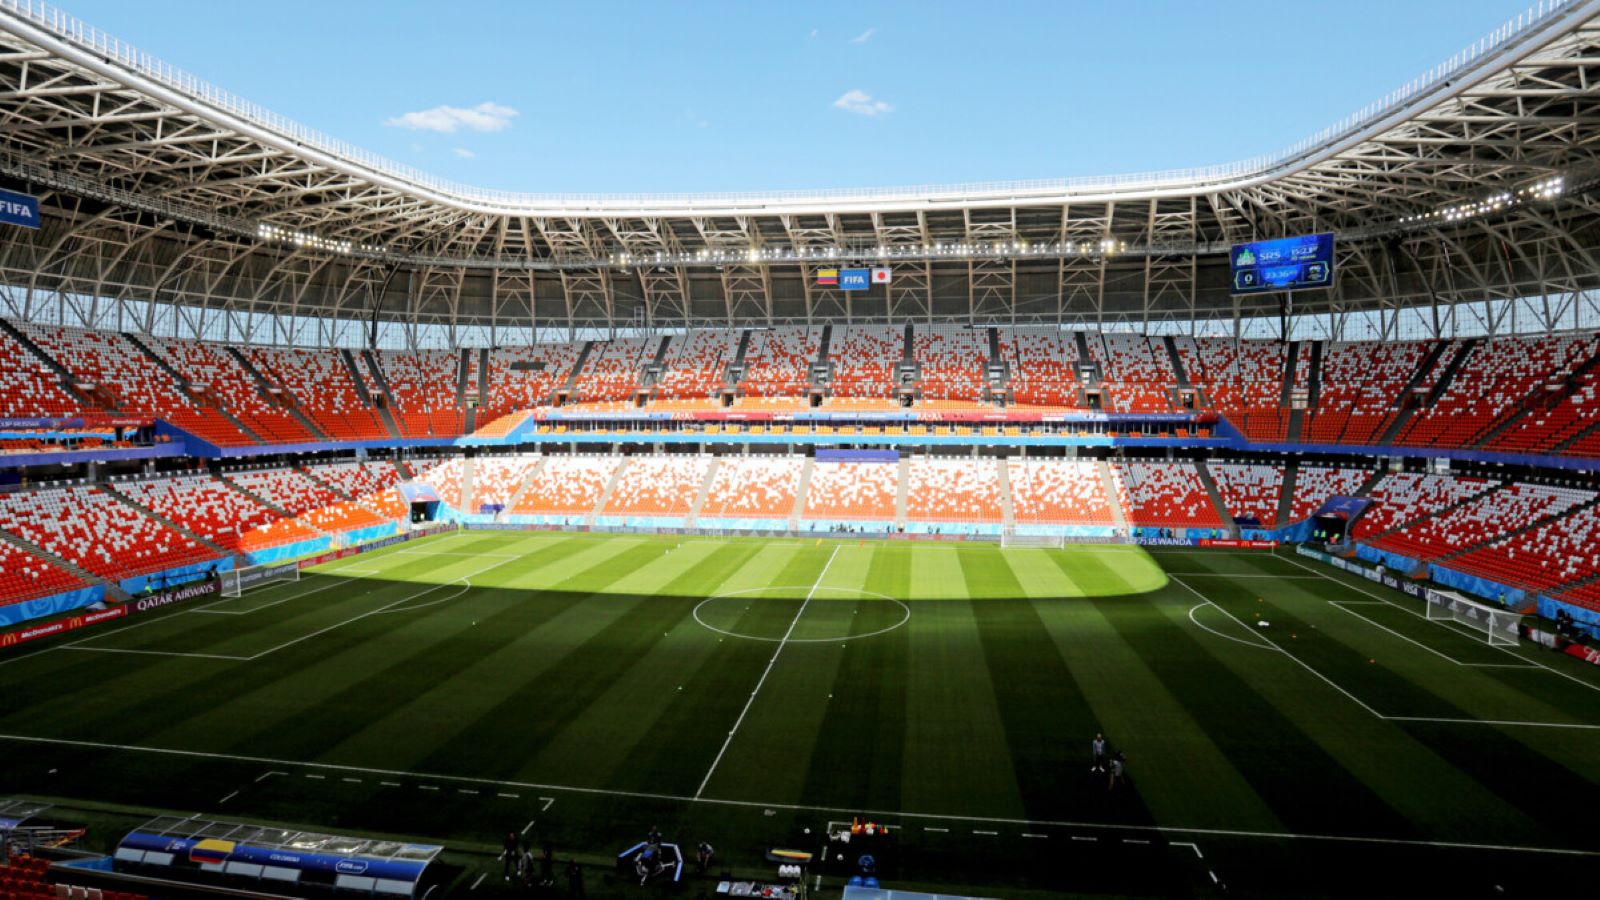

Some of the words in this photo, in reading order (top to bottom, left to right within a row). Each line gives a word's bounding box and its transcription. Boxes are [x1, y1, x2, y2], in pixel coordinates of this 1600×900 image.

[0, 200, 32, 217] FIFA
[844, 276, 865, 284] FIFA
[1158, 538, 1192, 546] WANDA
[1384, 575, 1398, 588] VISA
[1403, 582, 1418, 596] VISA
[137, 592, 172, 611] QATAR
[175, 583, 215, 600] AIRWAYS
[85, 608, 121, 622] McDonald's
[21, 623, 63, 639] McDonald's
